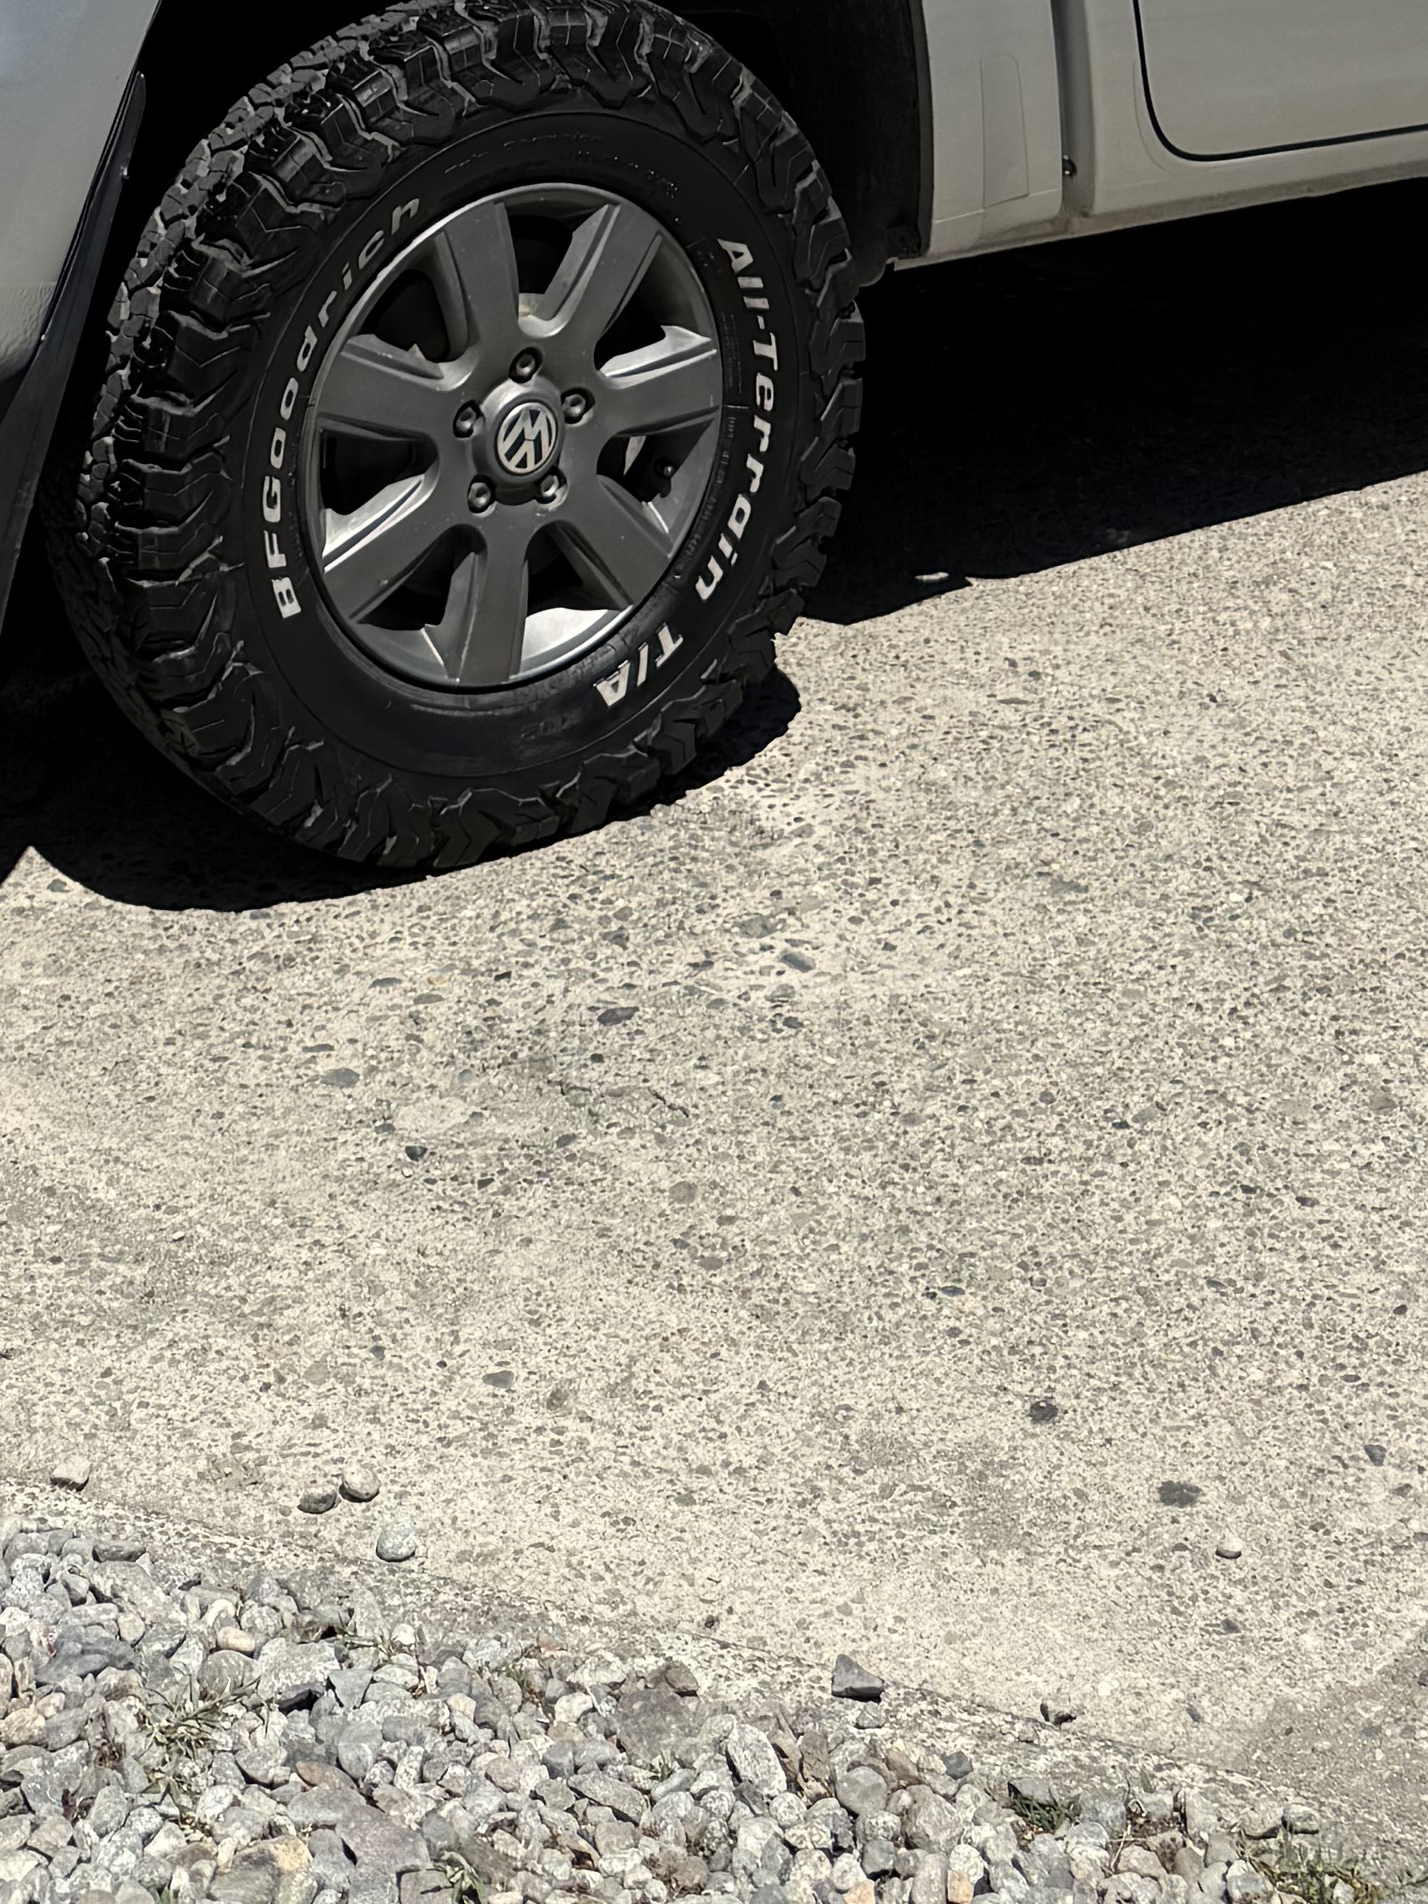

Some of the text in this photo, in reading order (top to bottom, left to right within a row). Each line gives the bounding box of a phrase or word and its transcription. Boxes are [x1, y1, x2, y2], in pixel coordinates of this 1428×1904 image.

[262, 197, 419, 620] BFGoodrich
[694, 237, 779, 602] All-Terrain
[595, 622, 684, 707] T/A
